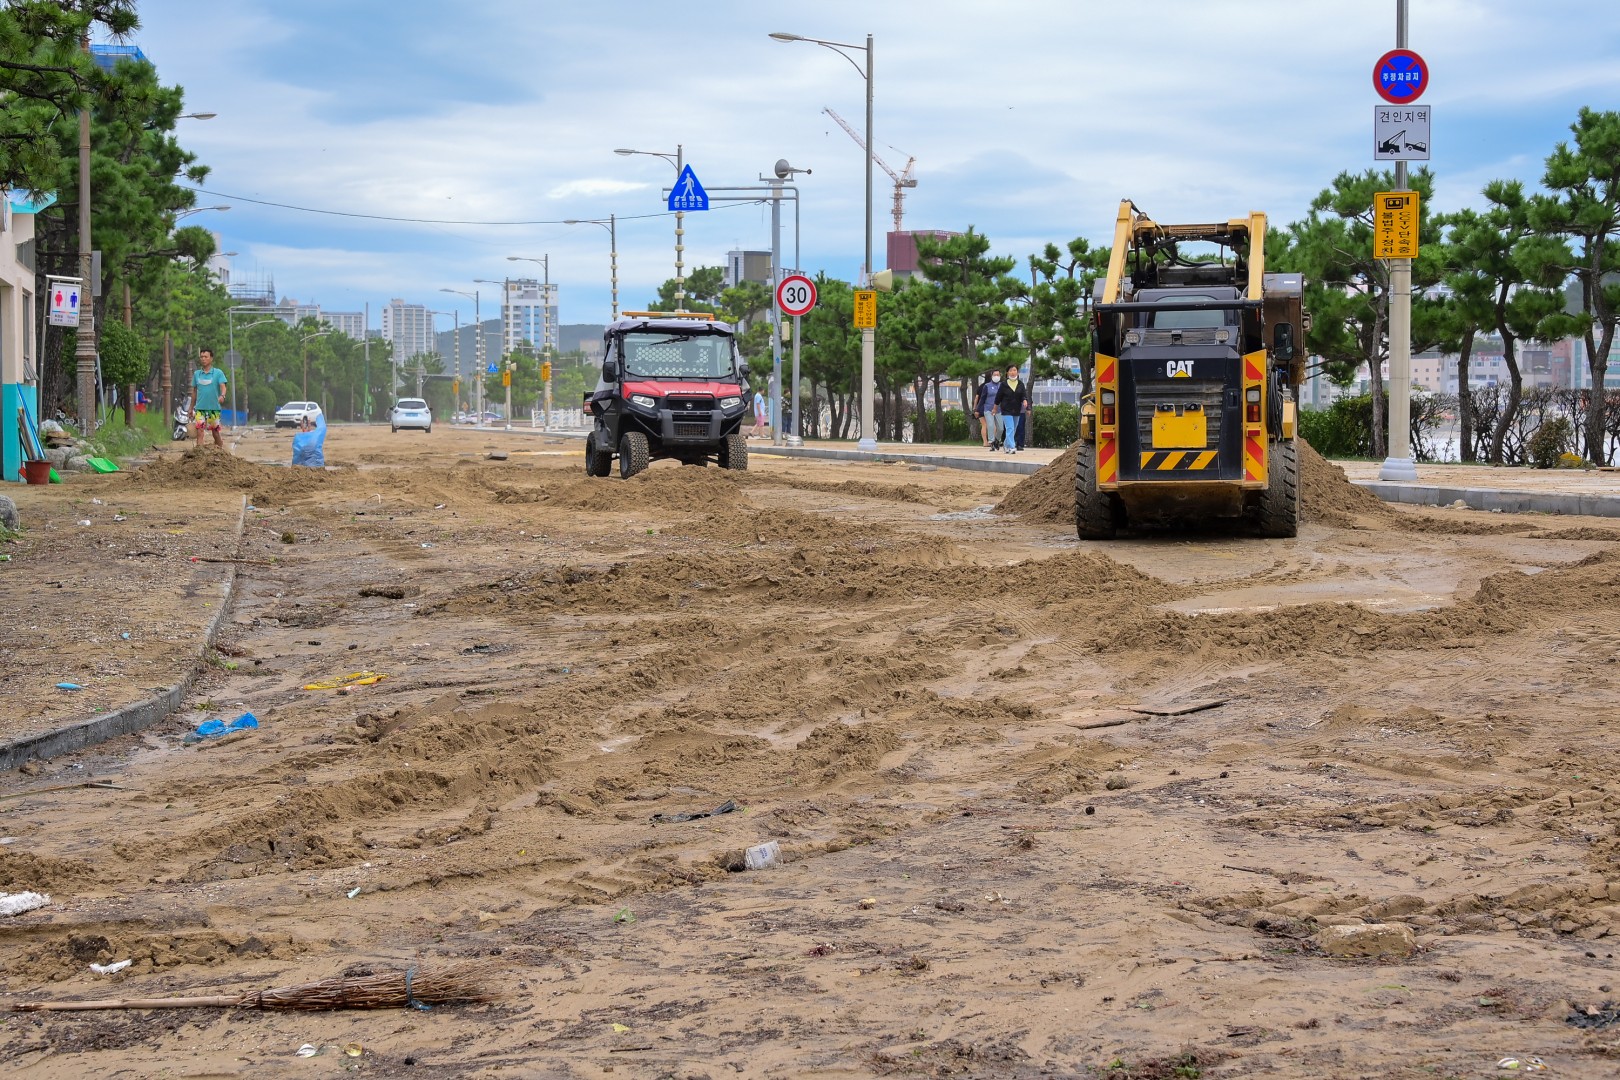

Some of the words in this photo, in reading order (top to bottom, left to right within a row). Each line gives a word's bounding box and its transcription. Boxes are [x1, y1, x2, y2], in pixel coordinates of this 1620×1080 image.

[1382, 72, 1419, 82] 주정차금지
[1380, 110, 1427, 123] 견인지역
[786, 286, 807, 304] 30
[1166, 360, 1194, 378] CAT
